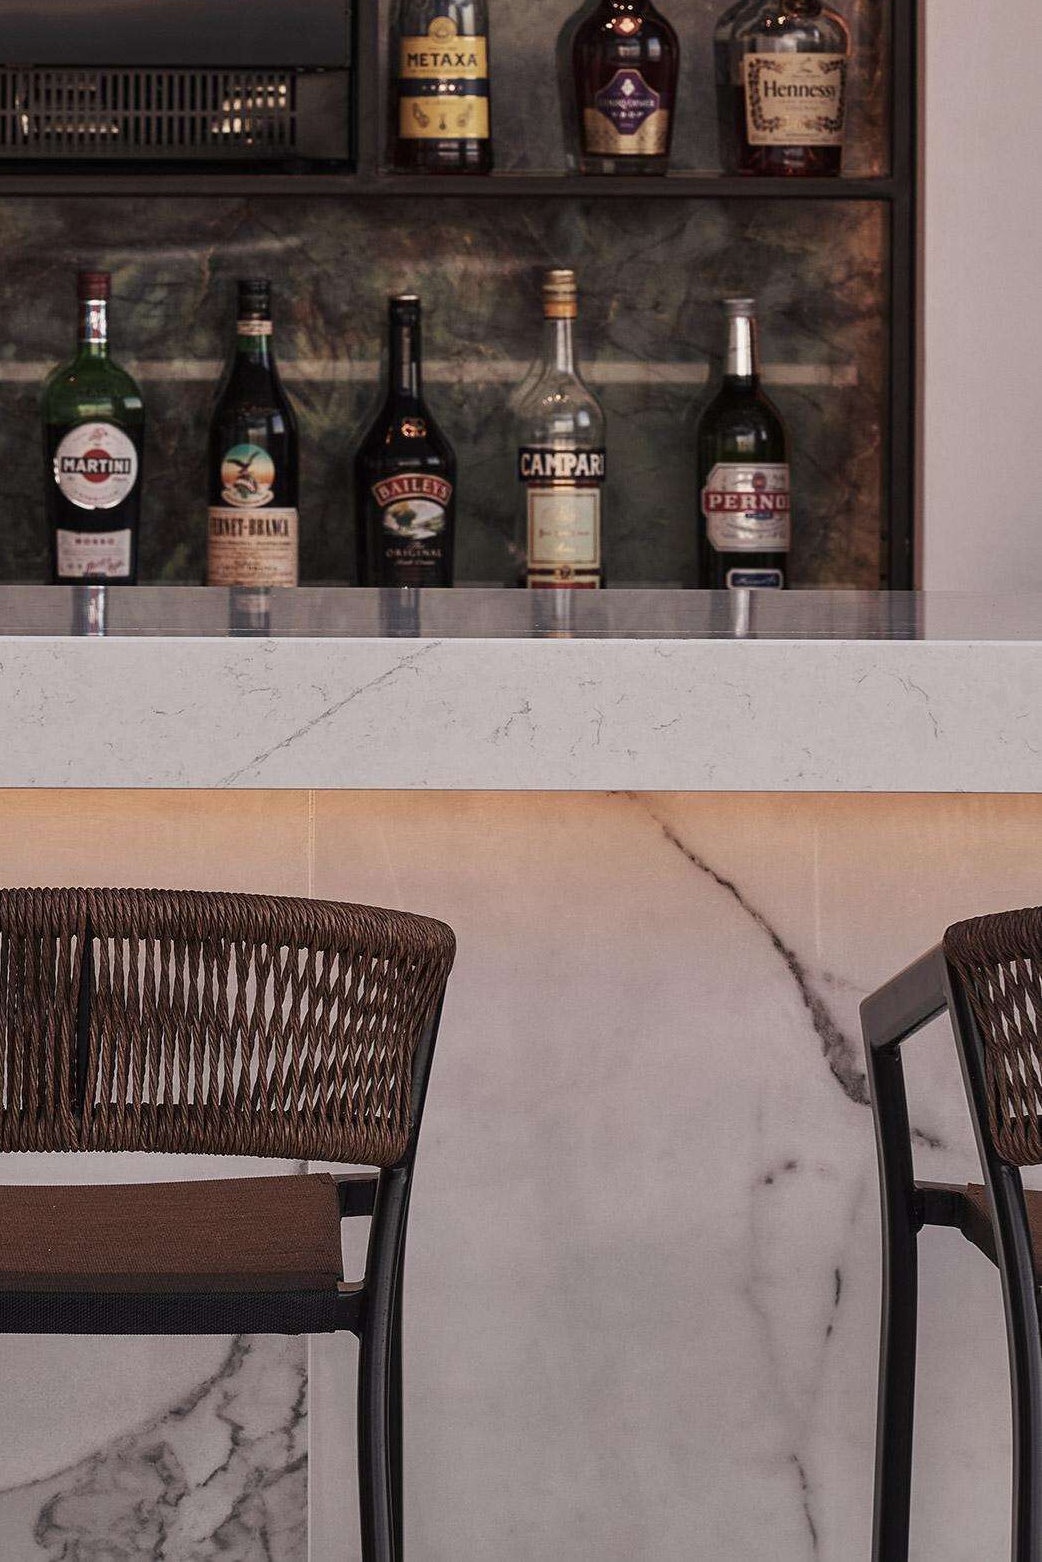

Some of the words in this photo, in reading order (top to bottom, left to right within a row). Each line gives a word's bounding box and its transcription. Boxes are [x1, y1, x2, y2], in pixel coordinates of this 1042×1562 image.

[407, 53, 478, 67] METAXA
[764, 80, 837, 101] Hennessy
[63, 458, 131, 473] MARTINI
[520, 452, 606, 476] CAMPARI
[378, 479, 448, 500] BAILEYS
